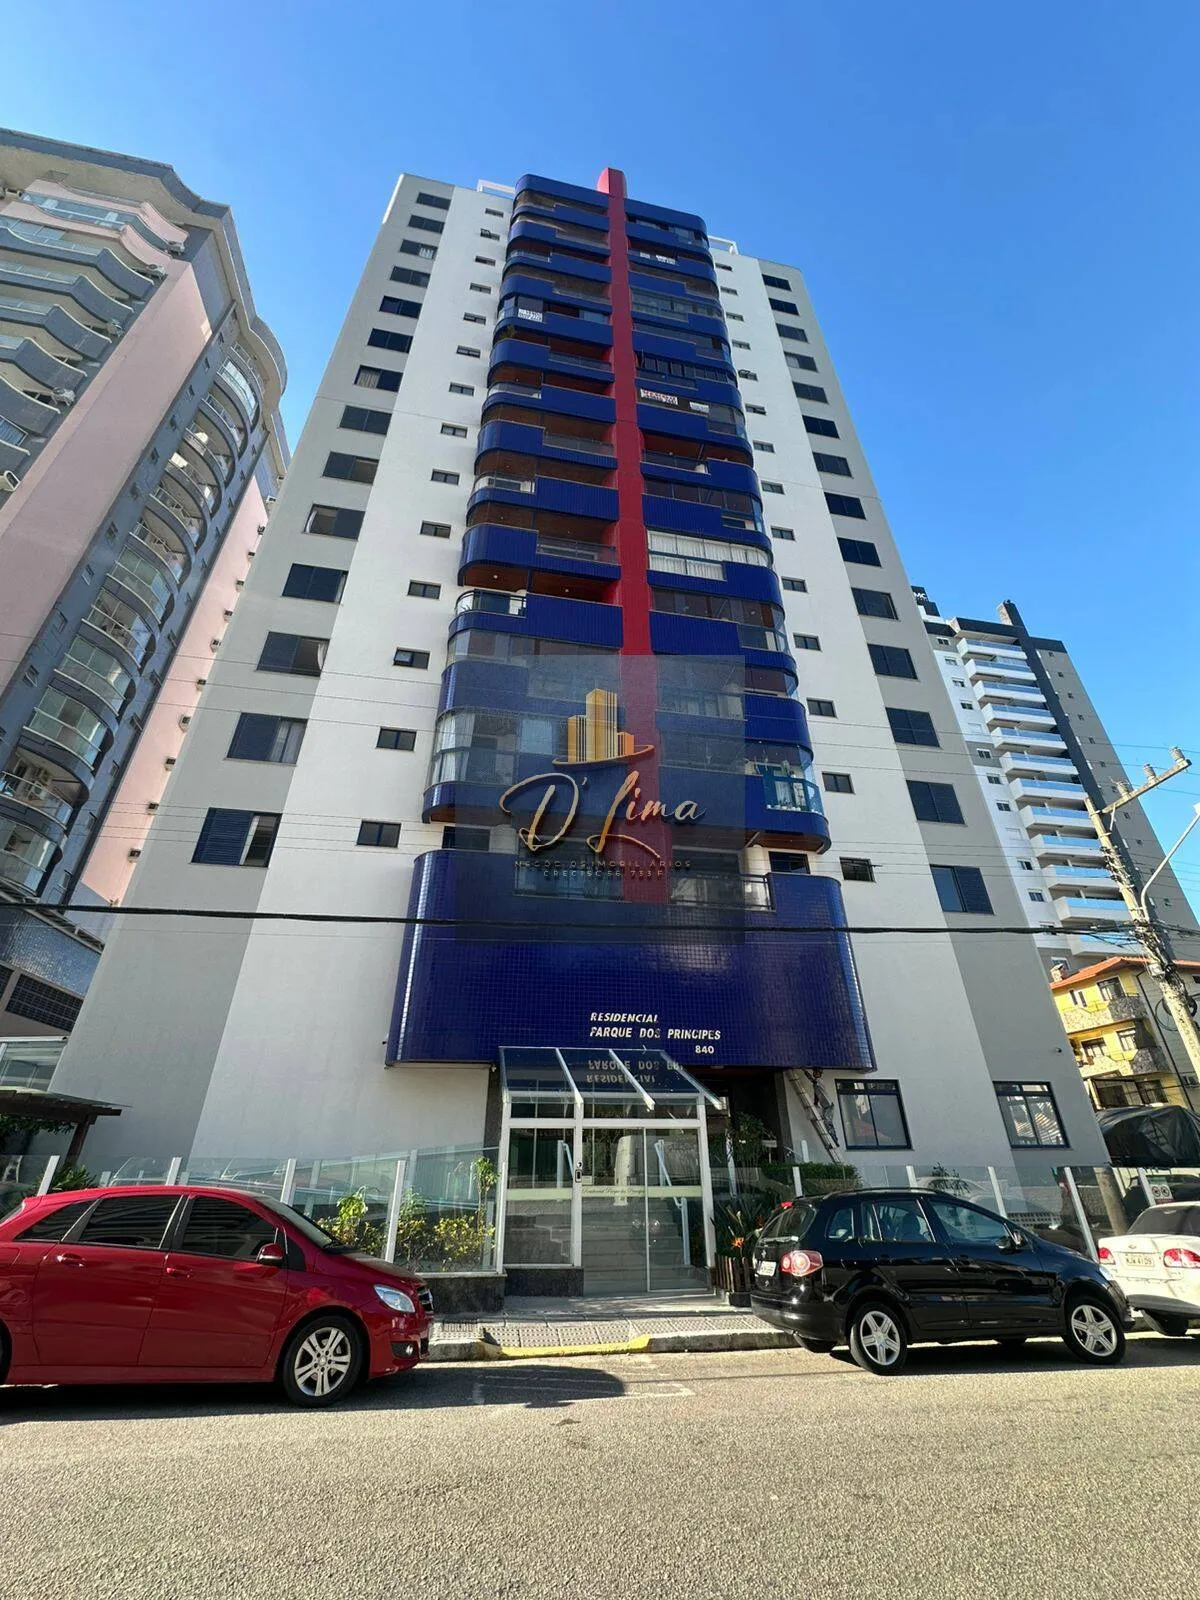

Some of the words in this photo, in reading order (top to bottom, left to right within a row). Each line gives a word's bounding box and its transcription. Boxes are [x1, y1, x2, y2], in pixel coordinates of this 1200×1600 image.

[589, 1026, 632, 1038] PARQUE
[639, 1027, 661, 1038] DOS
[667, 1029, 721, 1040] PRINCIPES
[694, 1045, 714, 1054] 840
